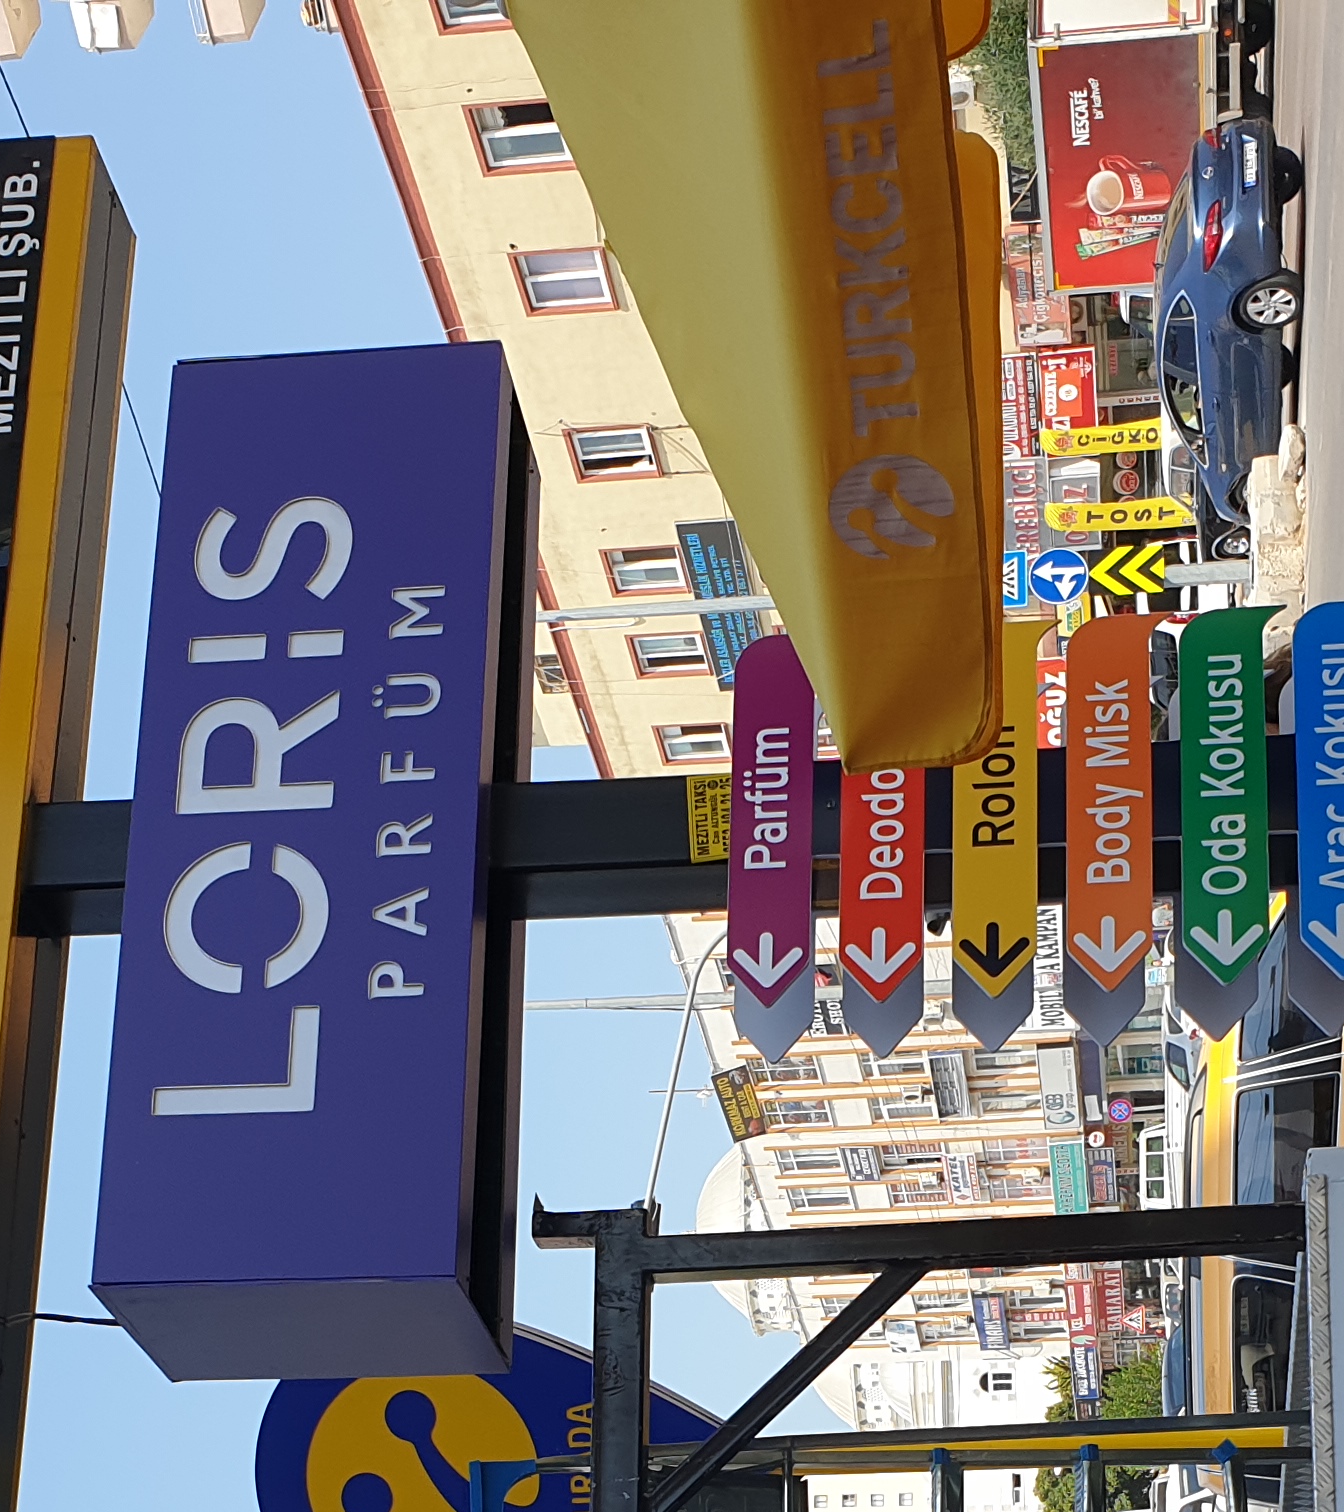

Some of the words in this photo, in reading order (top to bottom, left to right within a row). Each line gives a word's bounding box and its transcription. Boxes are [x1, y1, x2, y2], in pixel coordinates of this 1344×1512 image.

[1069, 89, 1091, 147] NESCAFÉ
[818, 19, 921, 437] TURKCELL
[1063, 483, 1089, 544] OZ
[1086, 505, 1176, 524] TOST
[1039, 671, 1067, 746] OĞUZ
[1082, 679, 1130, 766] Misk
[1197, 653, 1246, 798] Kokusu
[151, 496, 354, 1116] LORIS
[368, 584, 447, 999] PARFÜM
[742, 726, 790, 870] Parfüm
[1085, 782, 1144, 885] Body
[858, 768, 905, 901] Deodo
[1199, 813, 1248, 896] Oda
[716, 1077, 734, 1099] AUTO
[946, 1155, 962, 1193] KATEL
[1104, 1271, 1123, 1331] BAHARAT
